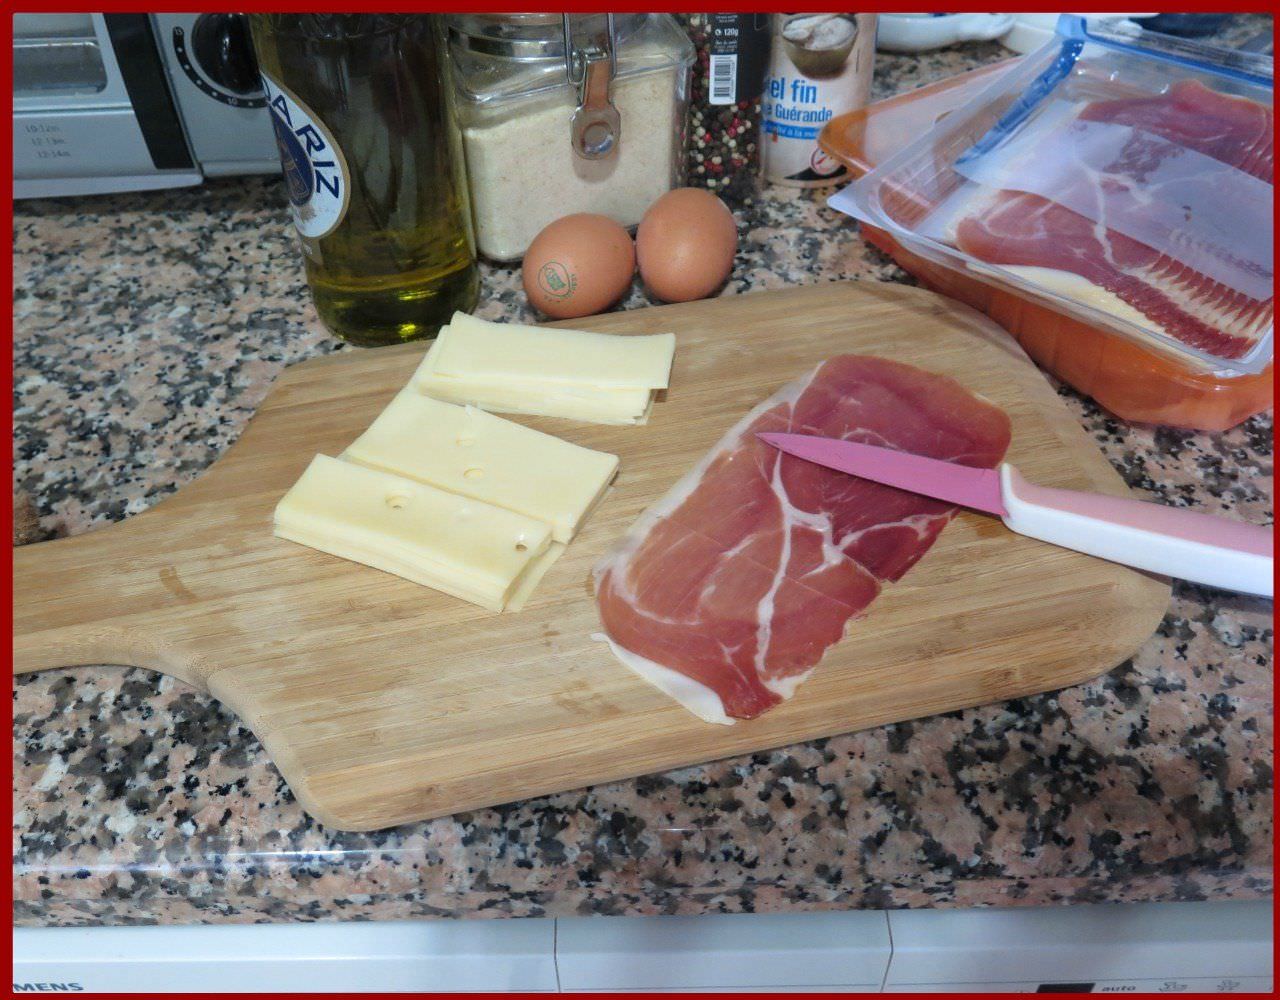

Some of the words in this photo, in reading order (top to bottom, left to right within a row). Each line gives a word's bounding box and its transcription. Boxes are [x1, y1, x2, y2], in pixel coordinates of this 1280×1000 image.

[724, 27, 739, 37] 120g
[790, 79, 817, 104] fin
[1102, 985, 1136, 993] auto
